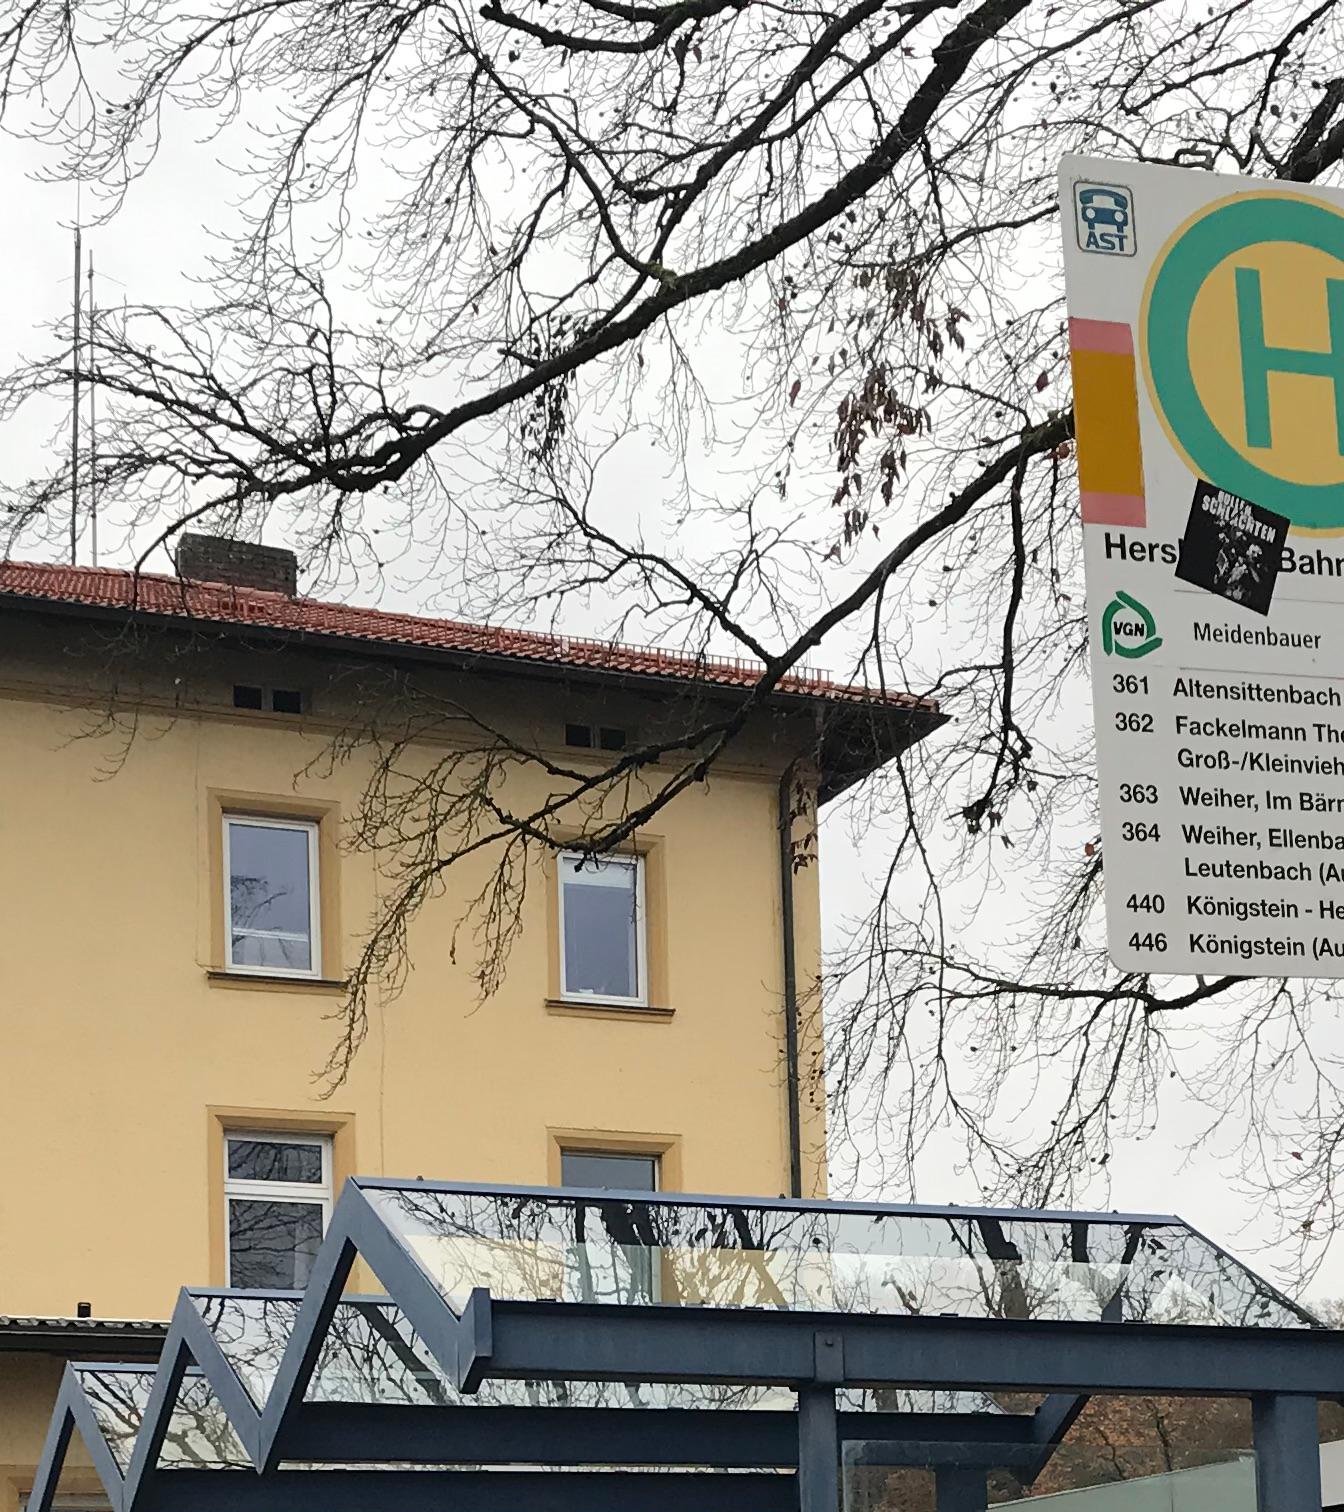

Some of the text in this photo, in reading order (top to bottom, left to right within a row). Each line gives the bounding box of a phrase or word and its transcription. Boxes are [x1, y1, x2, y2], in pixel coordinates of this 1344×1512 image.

[1086, 231, 1128, 251] AST
[1104, 533, 1184, 564] Hers
[1113, 621, 1145, 637] VGN
[1194, 622, 1322, 649] Meidenbauer
[1113, 674, 1150, 695] 361
[1173, 678, 1341, 707] Altensittenbach
[1115, 713, 1154, 733] 362
[1176, 716, 1306, 742] Fackelmann
[1119, 783, 1158, 804] 363
[1179, 786, 1259, 813] Weiher,
[1266, 790, 1292, 811] Im
[1122, 822, 1161, 843] 364
[1182, 825, 1261, 850] Weiher,
[1184, 858, 1312, 882] Leutenbach
[1126, 894, 1165, 915] 440
[1186, 895, 1299, 922] Königstein
[1129, 932, 1168, 952] 446
[1189, 934, 1305, 961] Königstein
